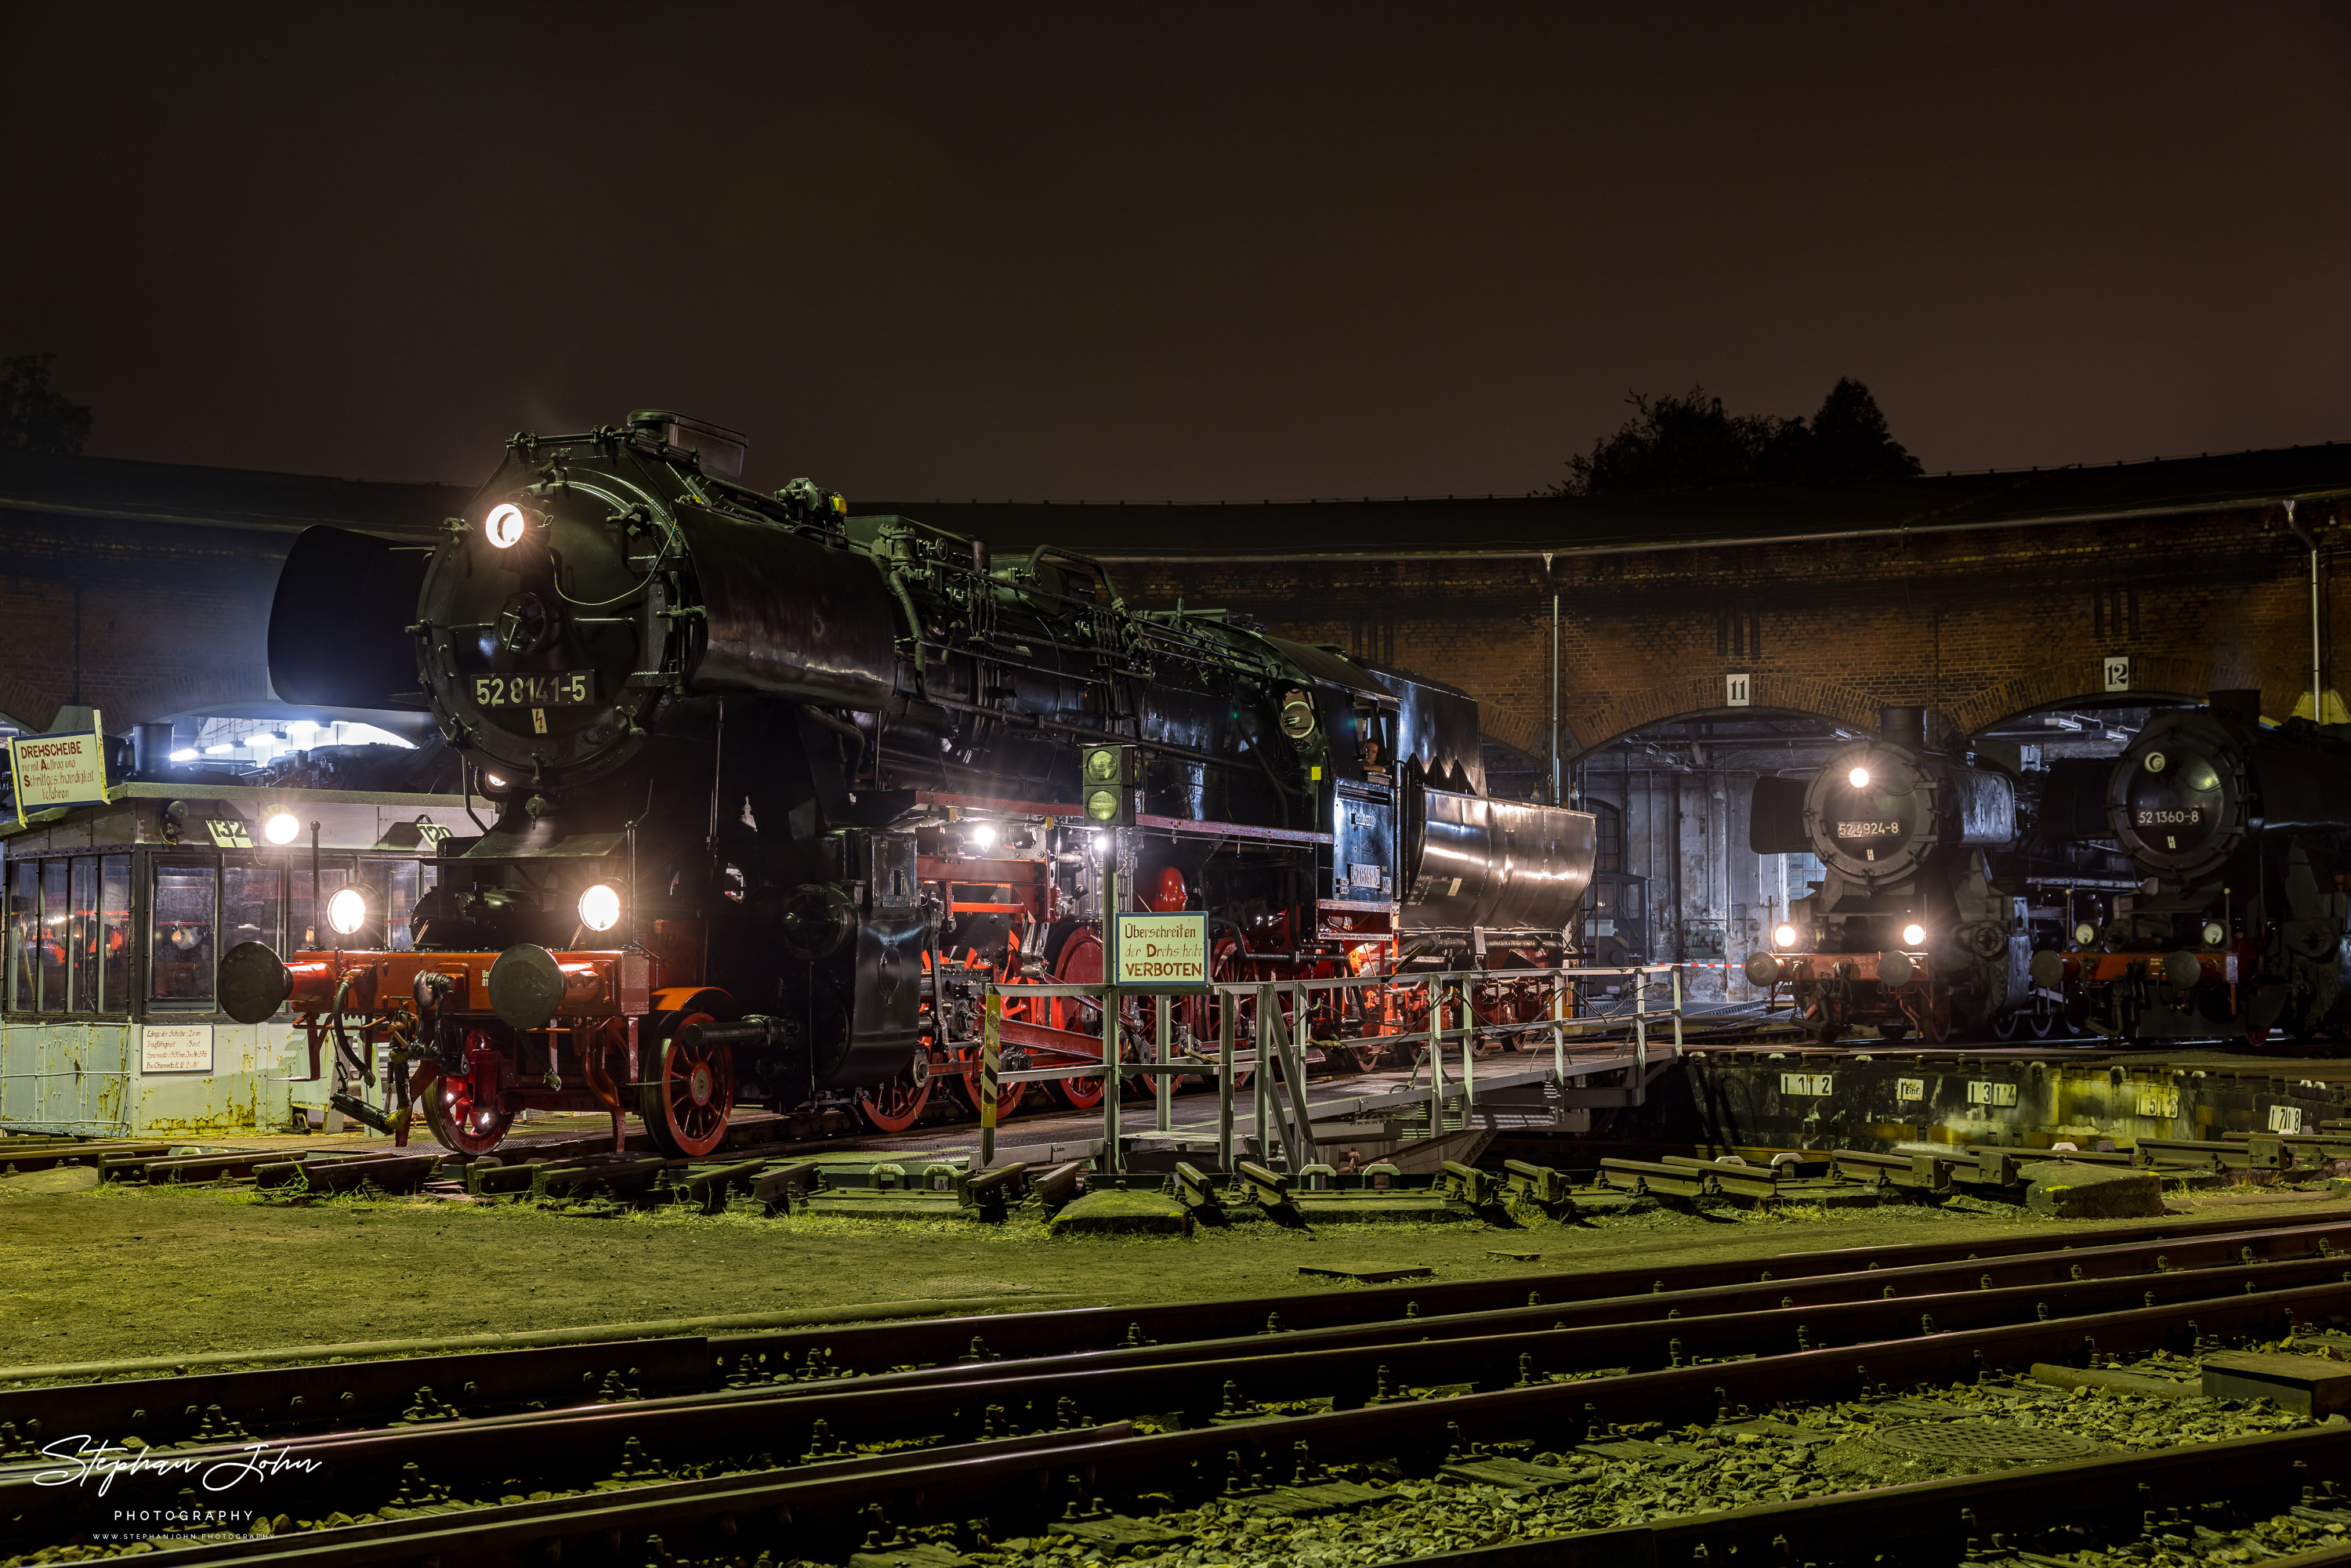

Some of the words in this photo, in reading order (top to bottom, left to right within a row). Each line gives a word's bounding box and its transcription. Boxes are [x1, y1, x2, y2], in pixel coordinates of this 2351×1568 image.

[2106, 663, 2128, 686] 12
[476, 679, 505, 704] 52
[510, 675, 586, 704] 8141-5
[1730, 679, 1747, 700] 11
[20, 741, 82, 759] DREHSCHEIBE
[65, 758, 76, 769] und
[2138, 812, 2153, 824] 52
[2155, 810, 2199, 823] 1360-8
[207, 820, 249, 838] 132
[1125, 923, 1196, 939] Überschreiten
[1125, 962, 1202, 977] VERBOTEN
[1798, 1076, 1805, 1094] 1
[1822, 1076, 1830, 1094] 2
[1983, 1084, 1991, 1103] 3
[2008, 1085, 2015, 1103] 4
[2279, 1108, 2286, 1129] 7
[2295, 1110, 2300, 1132] 8
